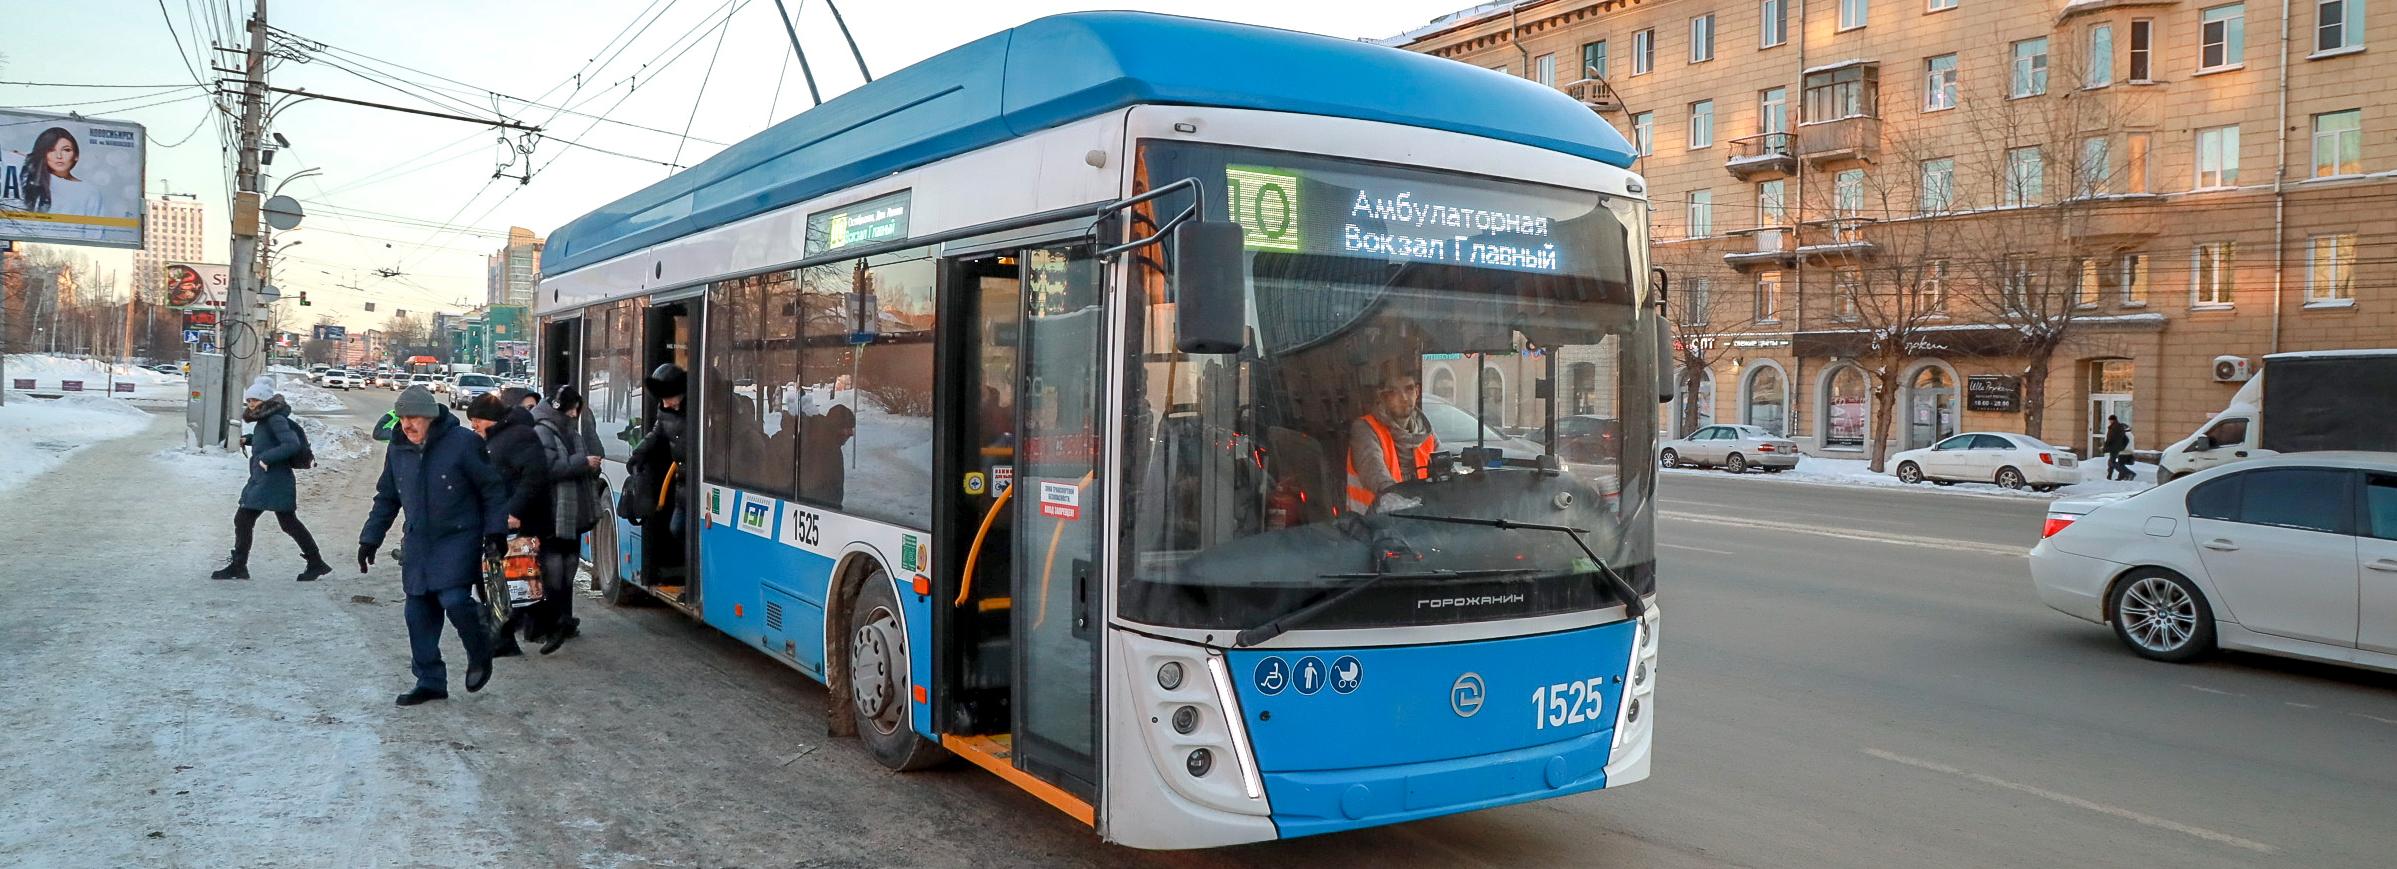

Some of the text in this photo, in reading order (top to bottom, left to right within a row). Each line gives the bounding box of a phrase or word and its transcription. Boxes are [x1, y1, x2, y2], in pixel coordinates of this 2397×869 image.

[1352, 190, 1548, 237] Амбулаторная
[1345, 223, 1556, 270] Вокзал Главный
[793, 509, 820, 547] 1525
[1417, 593, 1524, 609] ГОРОЖАНИН
[1531, 676, 1604, 730] 1525
